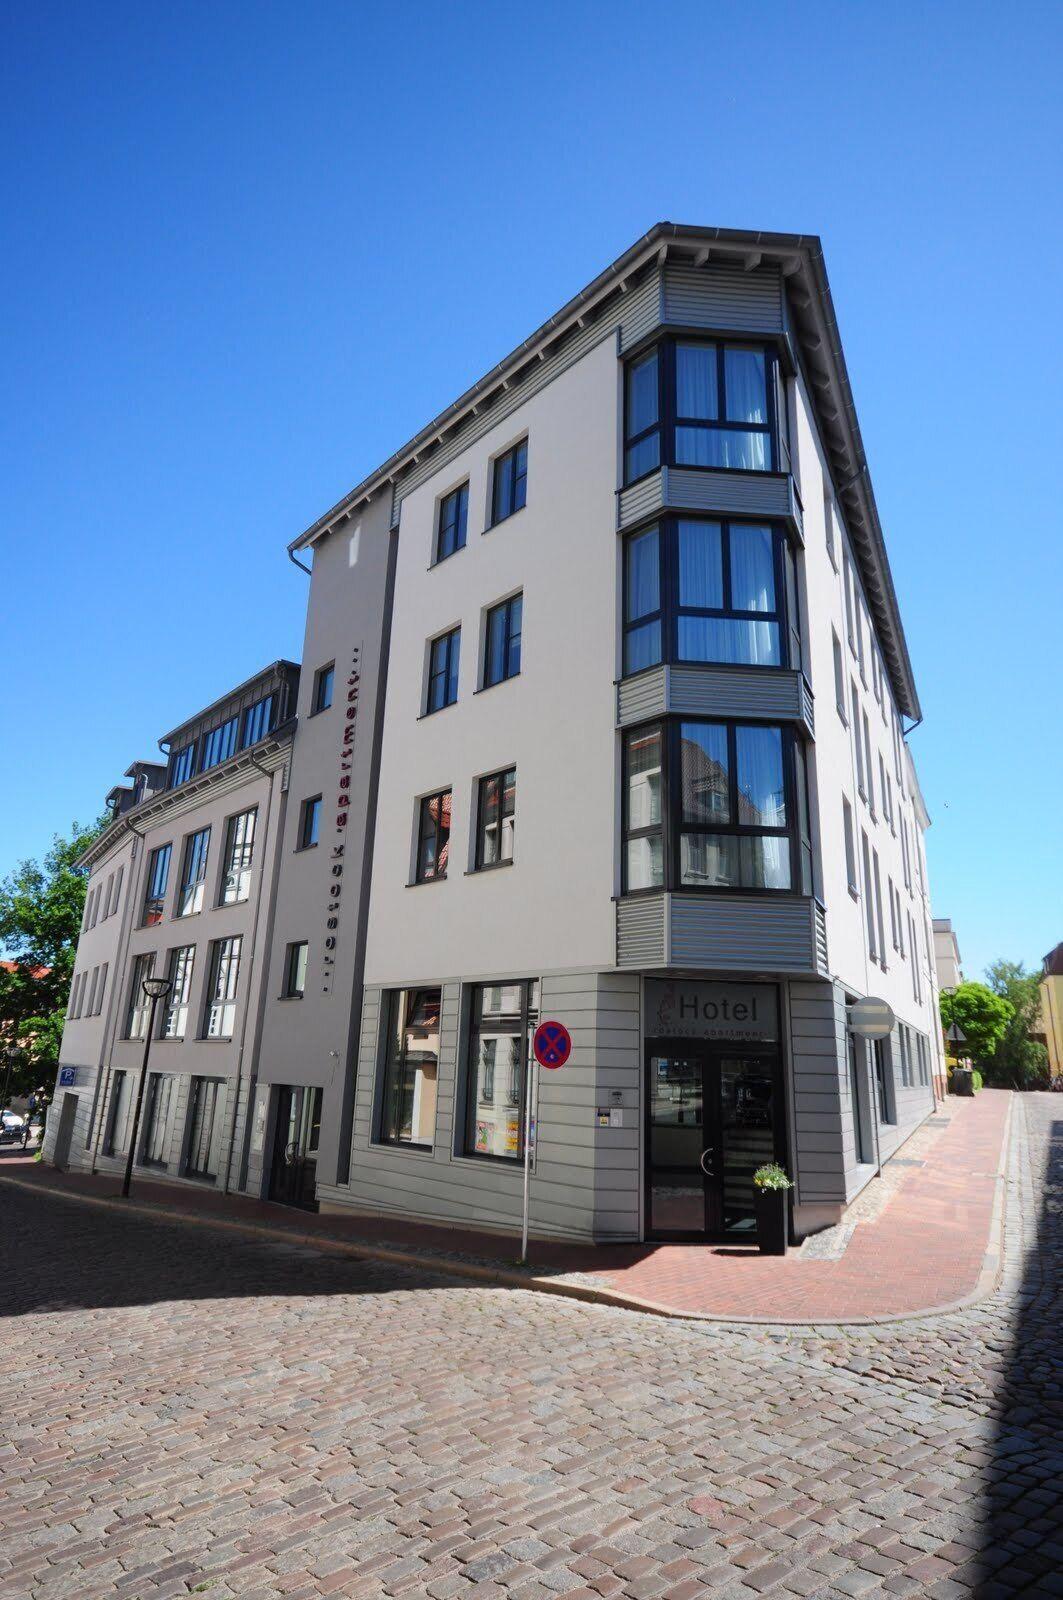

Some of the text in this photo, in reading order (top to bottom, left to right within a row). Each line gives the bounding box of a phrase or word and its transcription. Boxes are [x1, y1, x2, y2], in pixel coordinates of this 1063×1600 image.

[323, 674, 360, 965] rostock apartment
[680, 995, 757, 1022] Hotel
